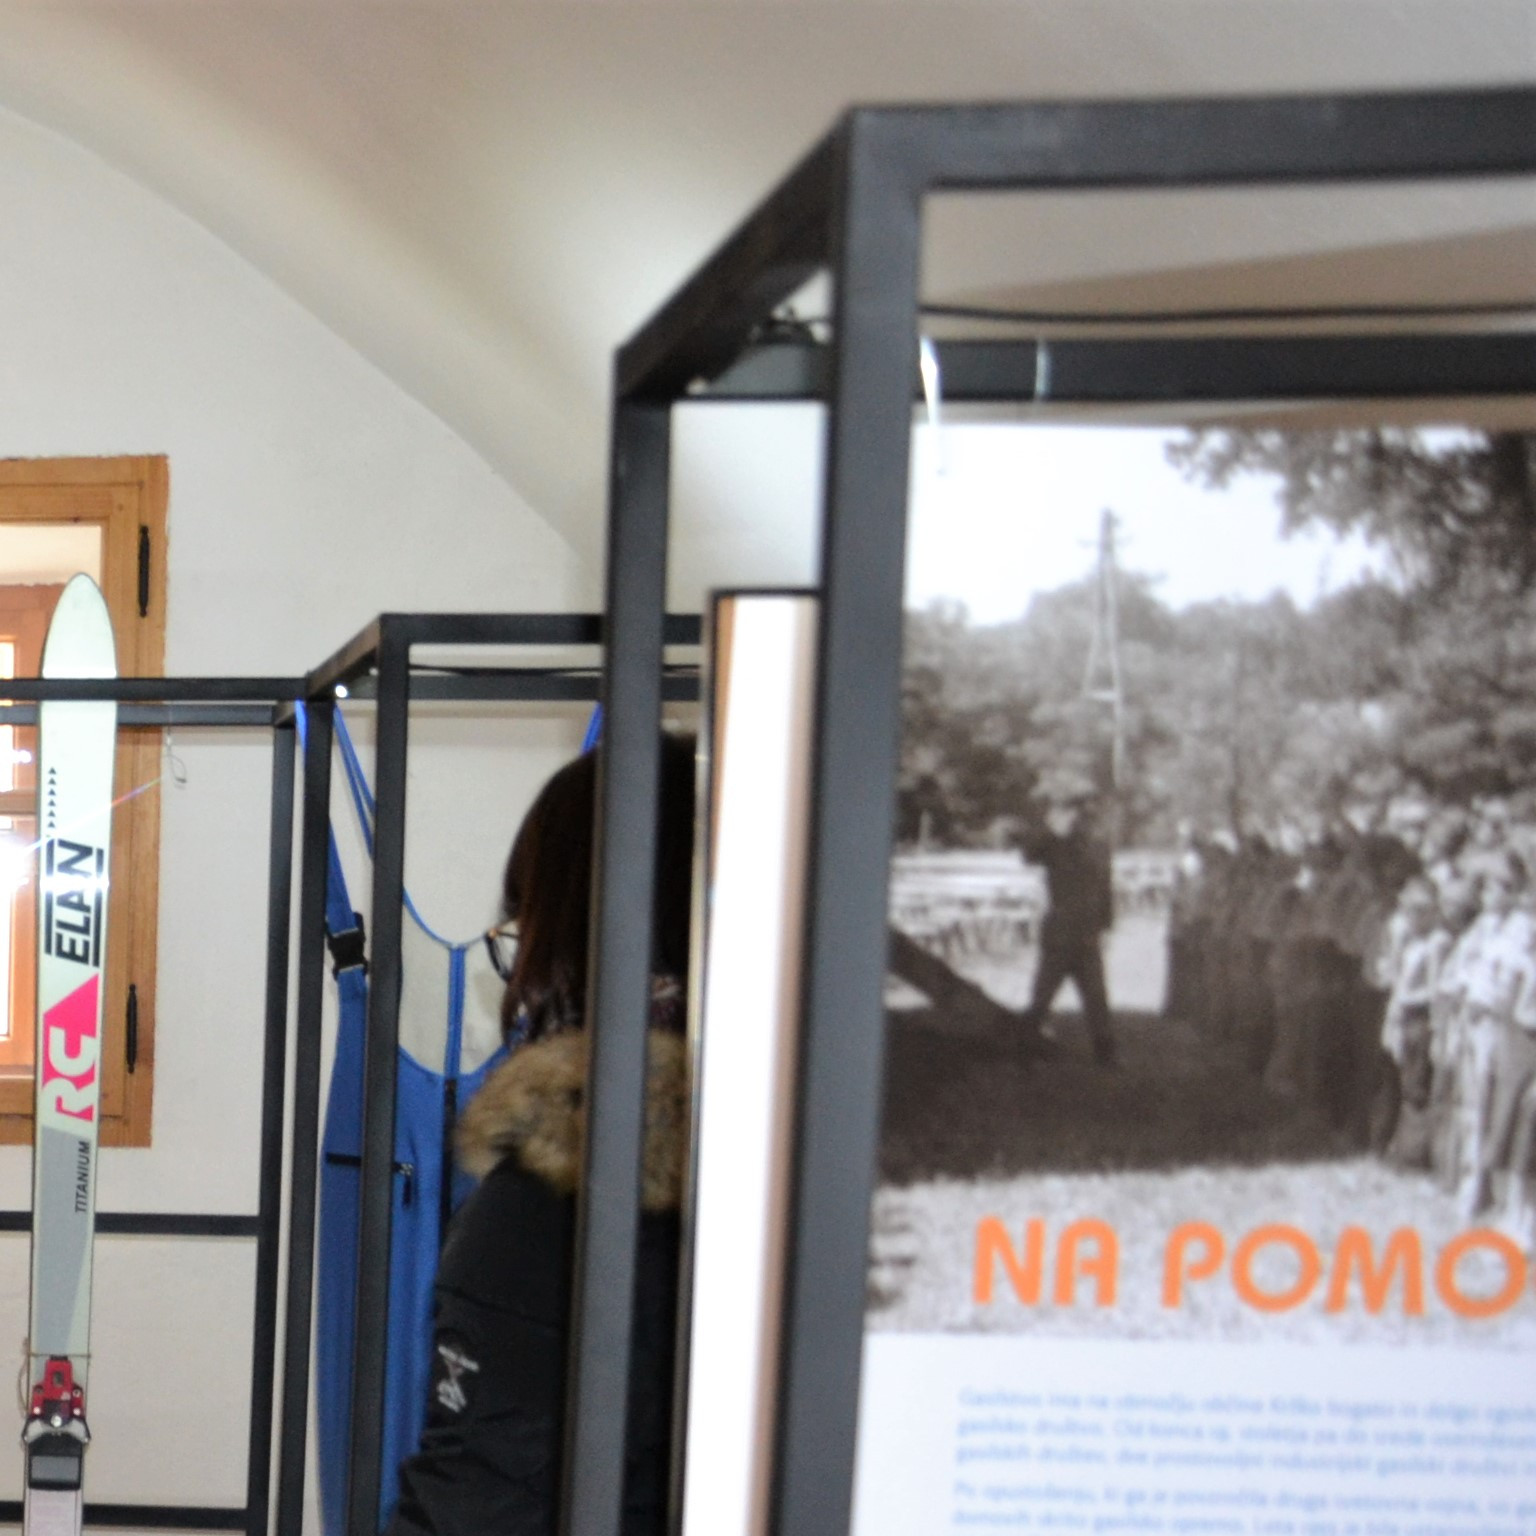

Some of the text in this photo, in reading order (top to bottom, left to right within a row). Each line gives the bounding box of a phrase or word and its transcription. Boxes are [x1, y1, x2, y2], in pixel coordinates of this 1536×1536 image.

[55, 839, 93, 965] ELAN
[41, 1025, 98, 1136] RC
[74, 1140, 92, 1215] TITANIUM
[971, 1216, 1536, 1320] NA POMO
